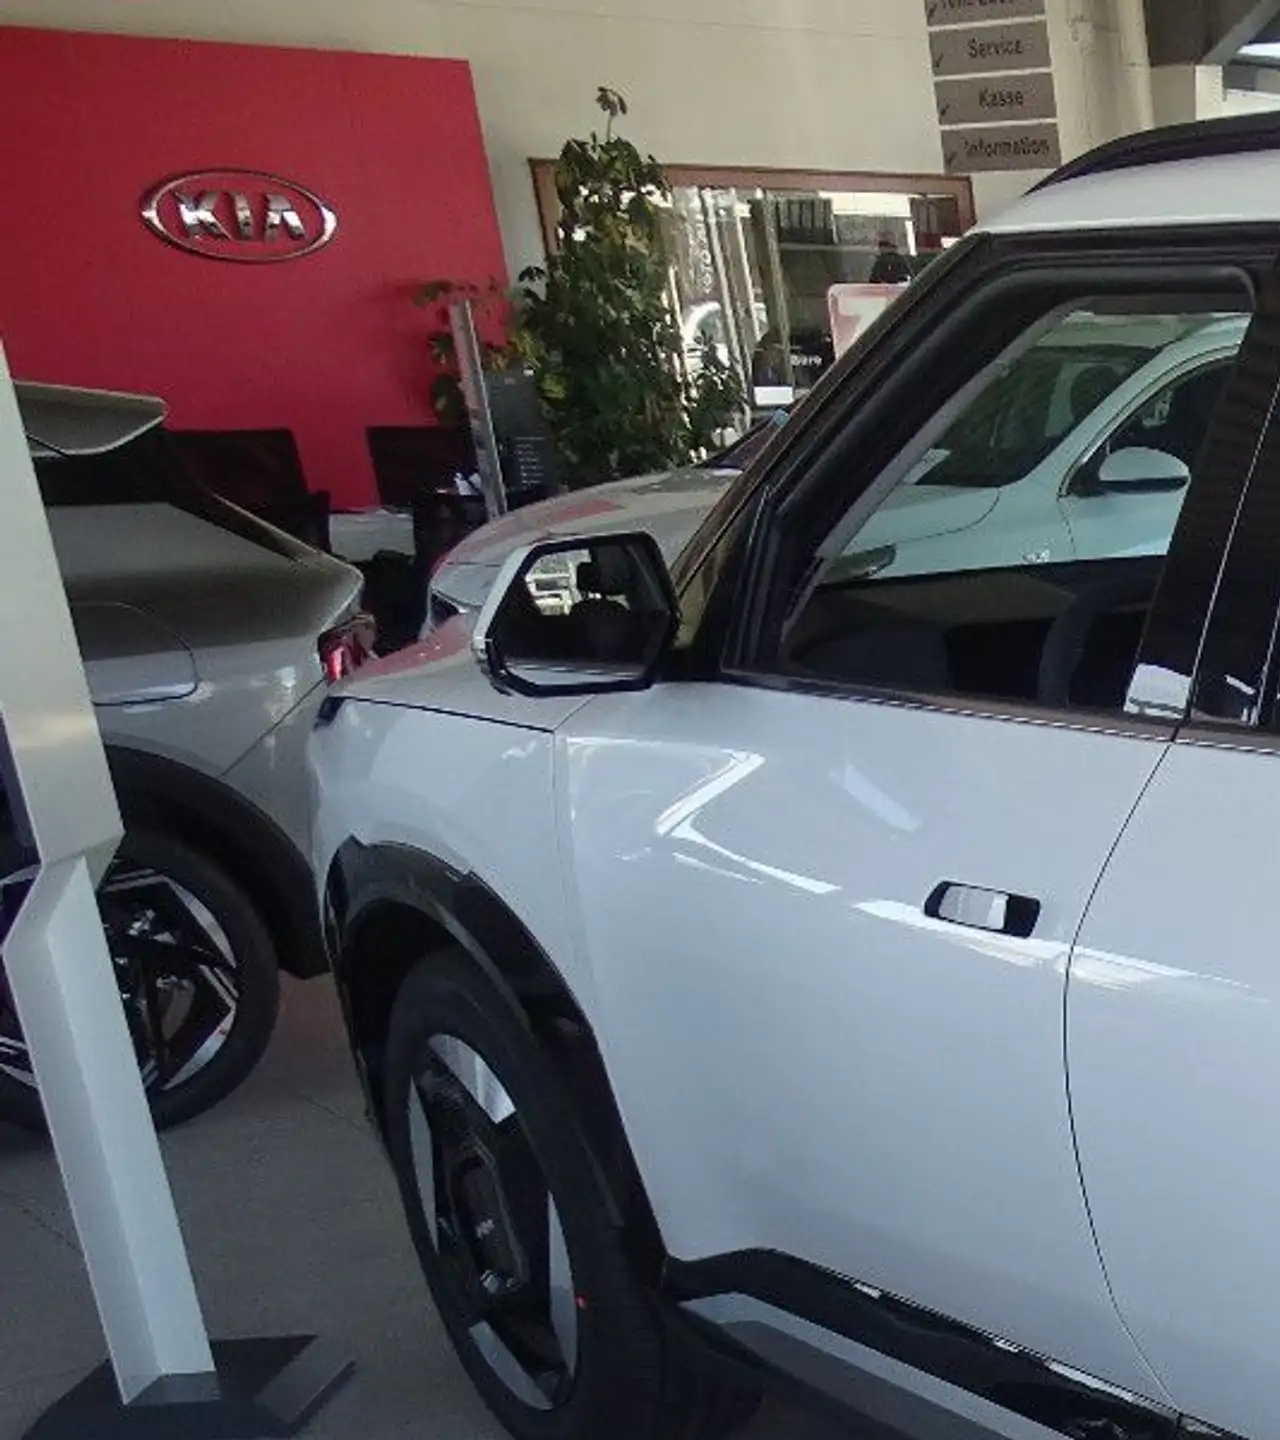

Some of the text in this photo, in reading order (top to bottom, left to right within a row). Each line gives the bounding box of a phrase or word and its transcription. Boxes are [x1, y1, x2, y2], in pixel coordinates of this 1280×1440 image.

[967, 37, 1024, 58] Service
[979, 87, 1024, 109] Kasse
[963, 136, 1051, 158] Information
[171, 186, 307, 242] KIA
